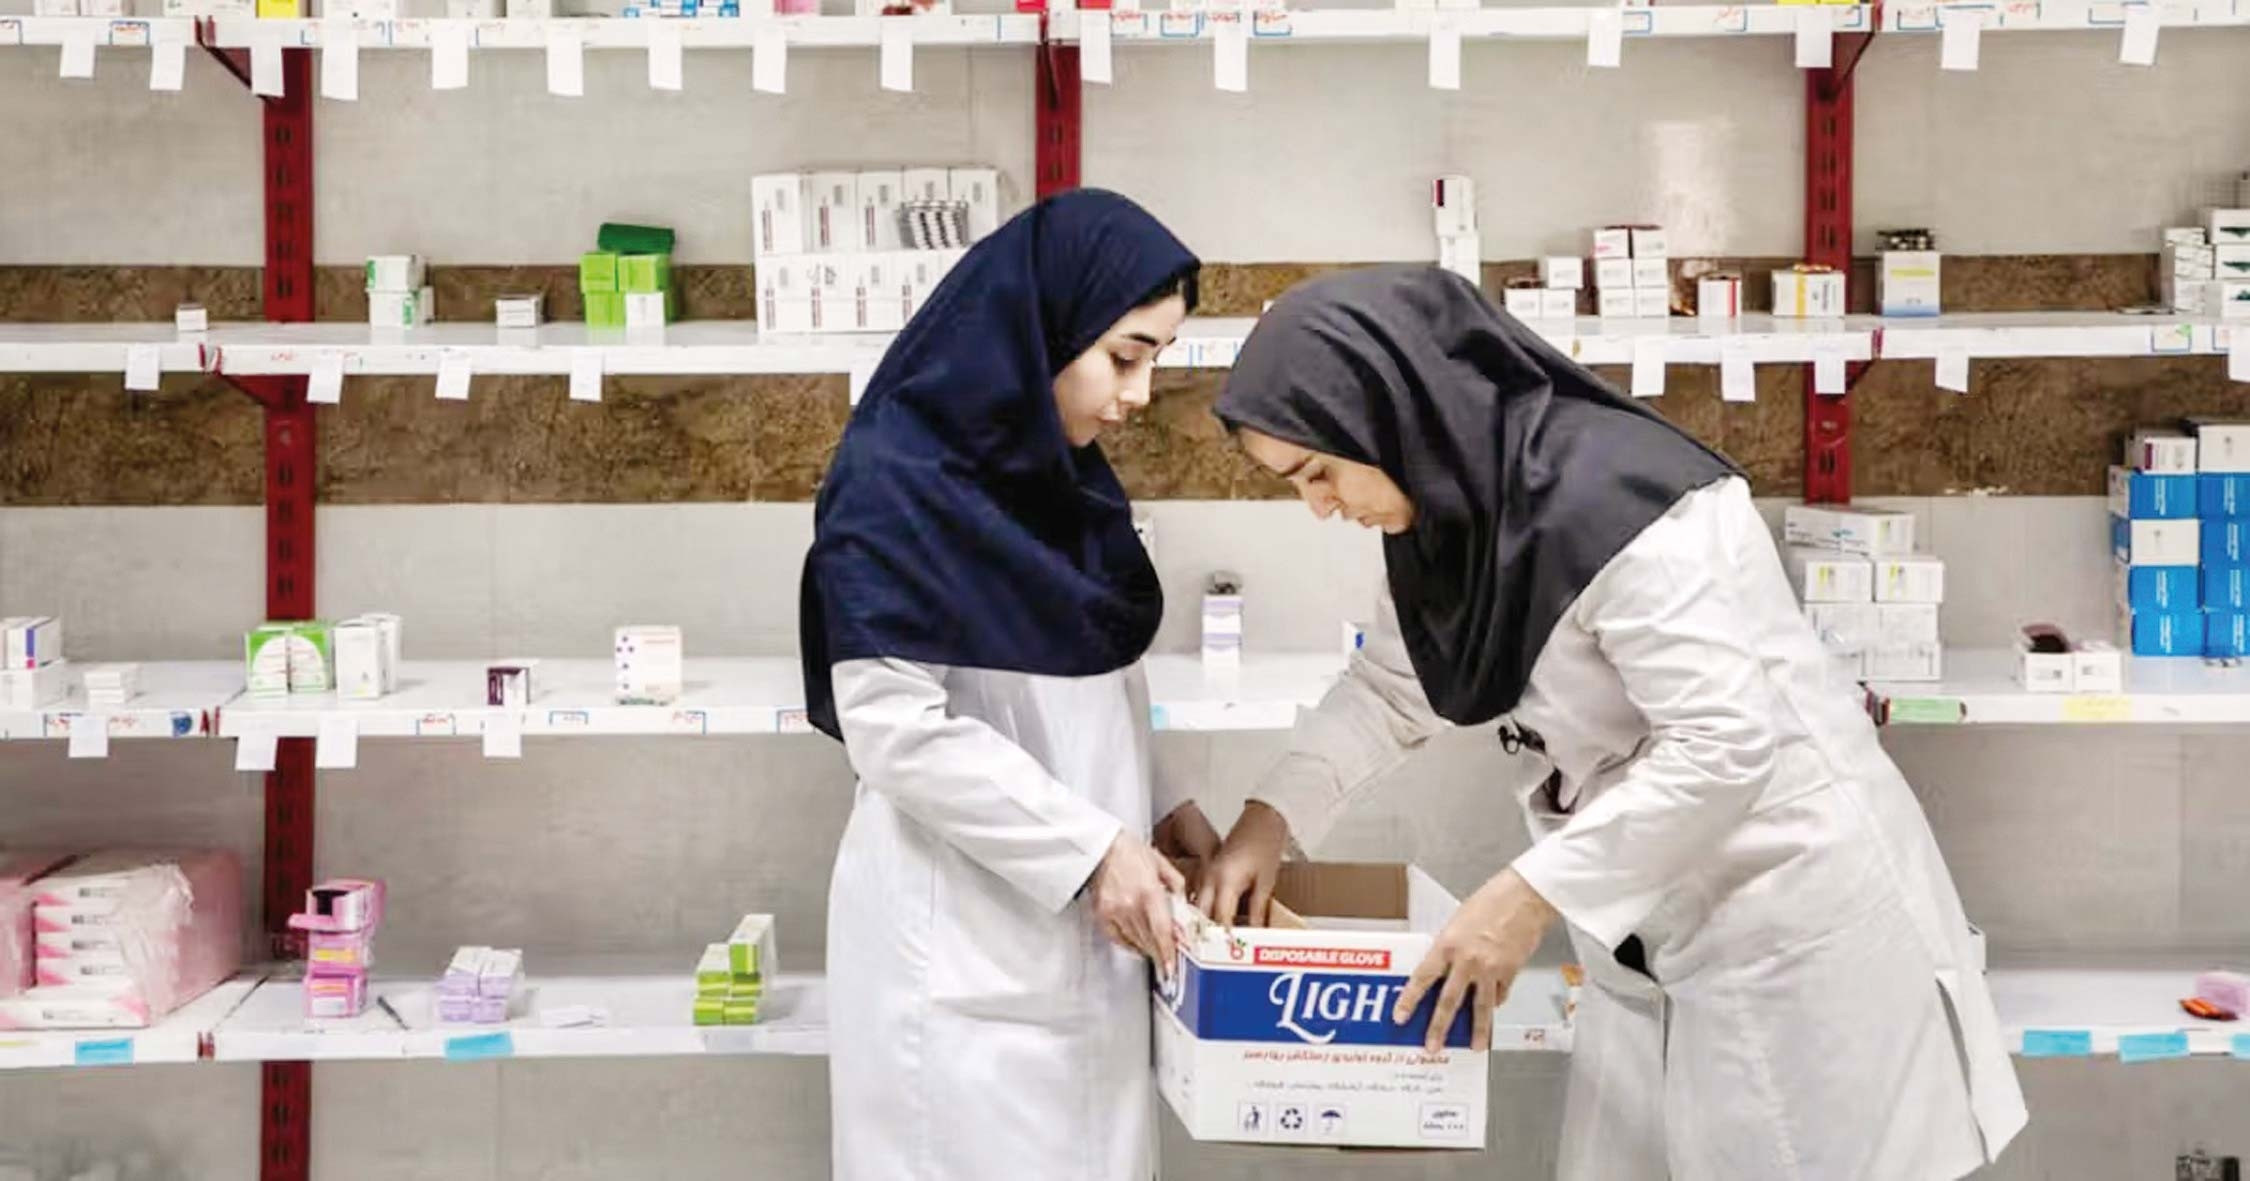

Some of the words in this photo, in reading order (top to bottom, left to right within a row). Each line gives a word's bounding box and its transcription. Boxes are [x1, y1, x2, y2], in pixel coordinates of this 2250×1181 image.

[1259, 948, 1337, 965] DISPOSABLE
[1339, 951, 1385, 967] GLOVE
[1269, 972, 1405, 1045] LIGH
